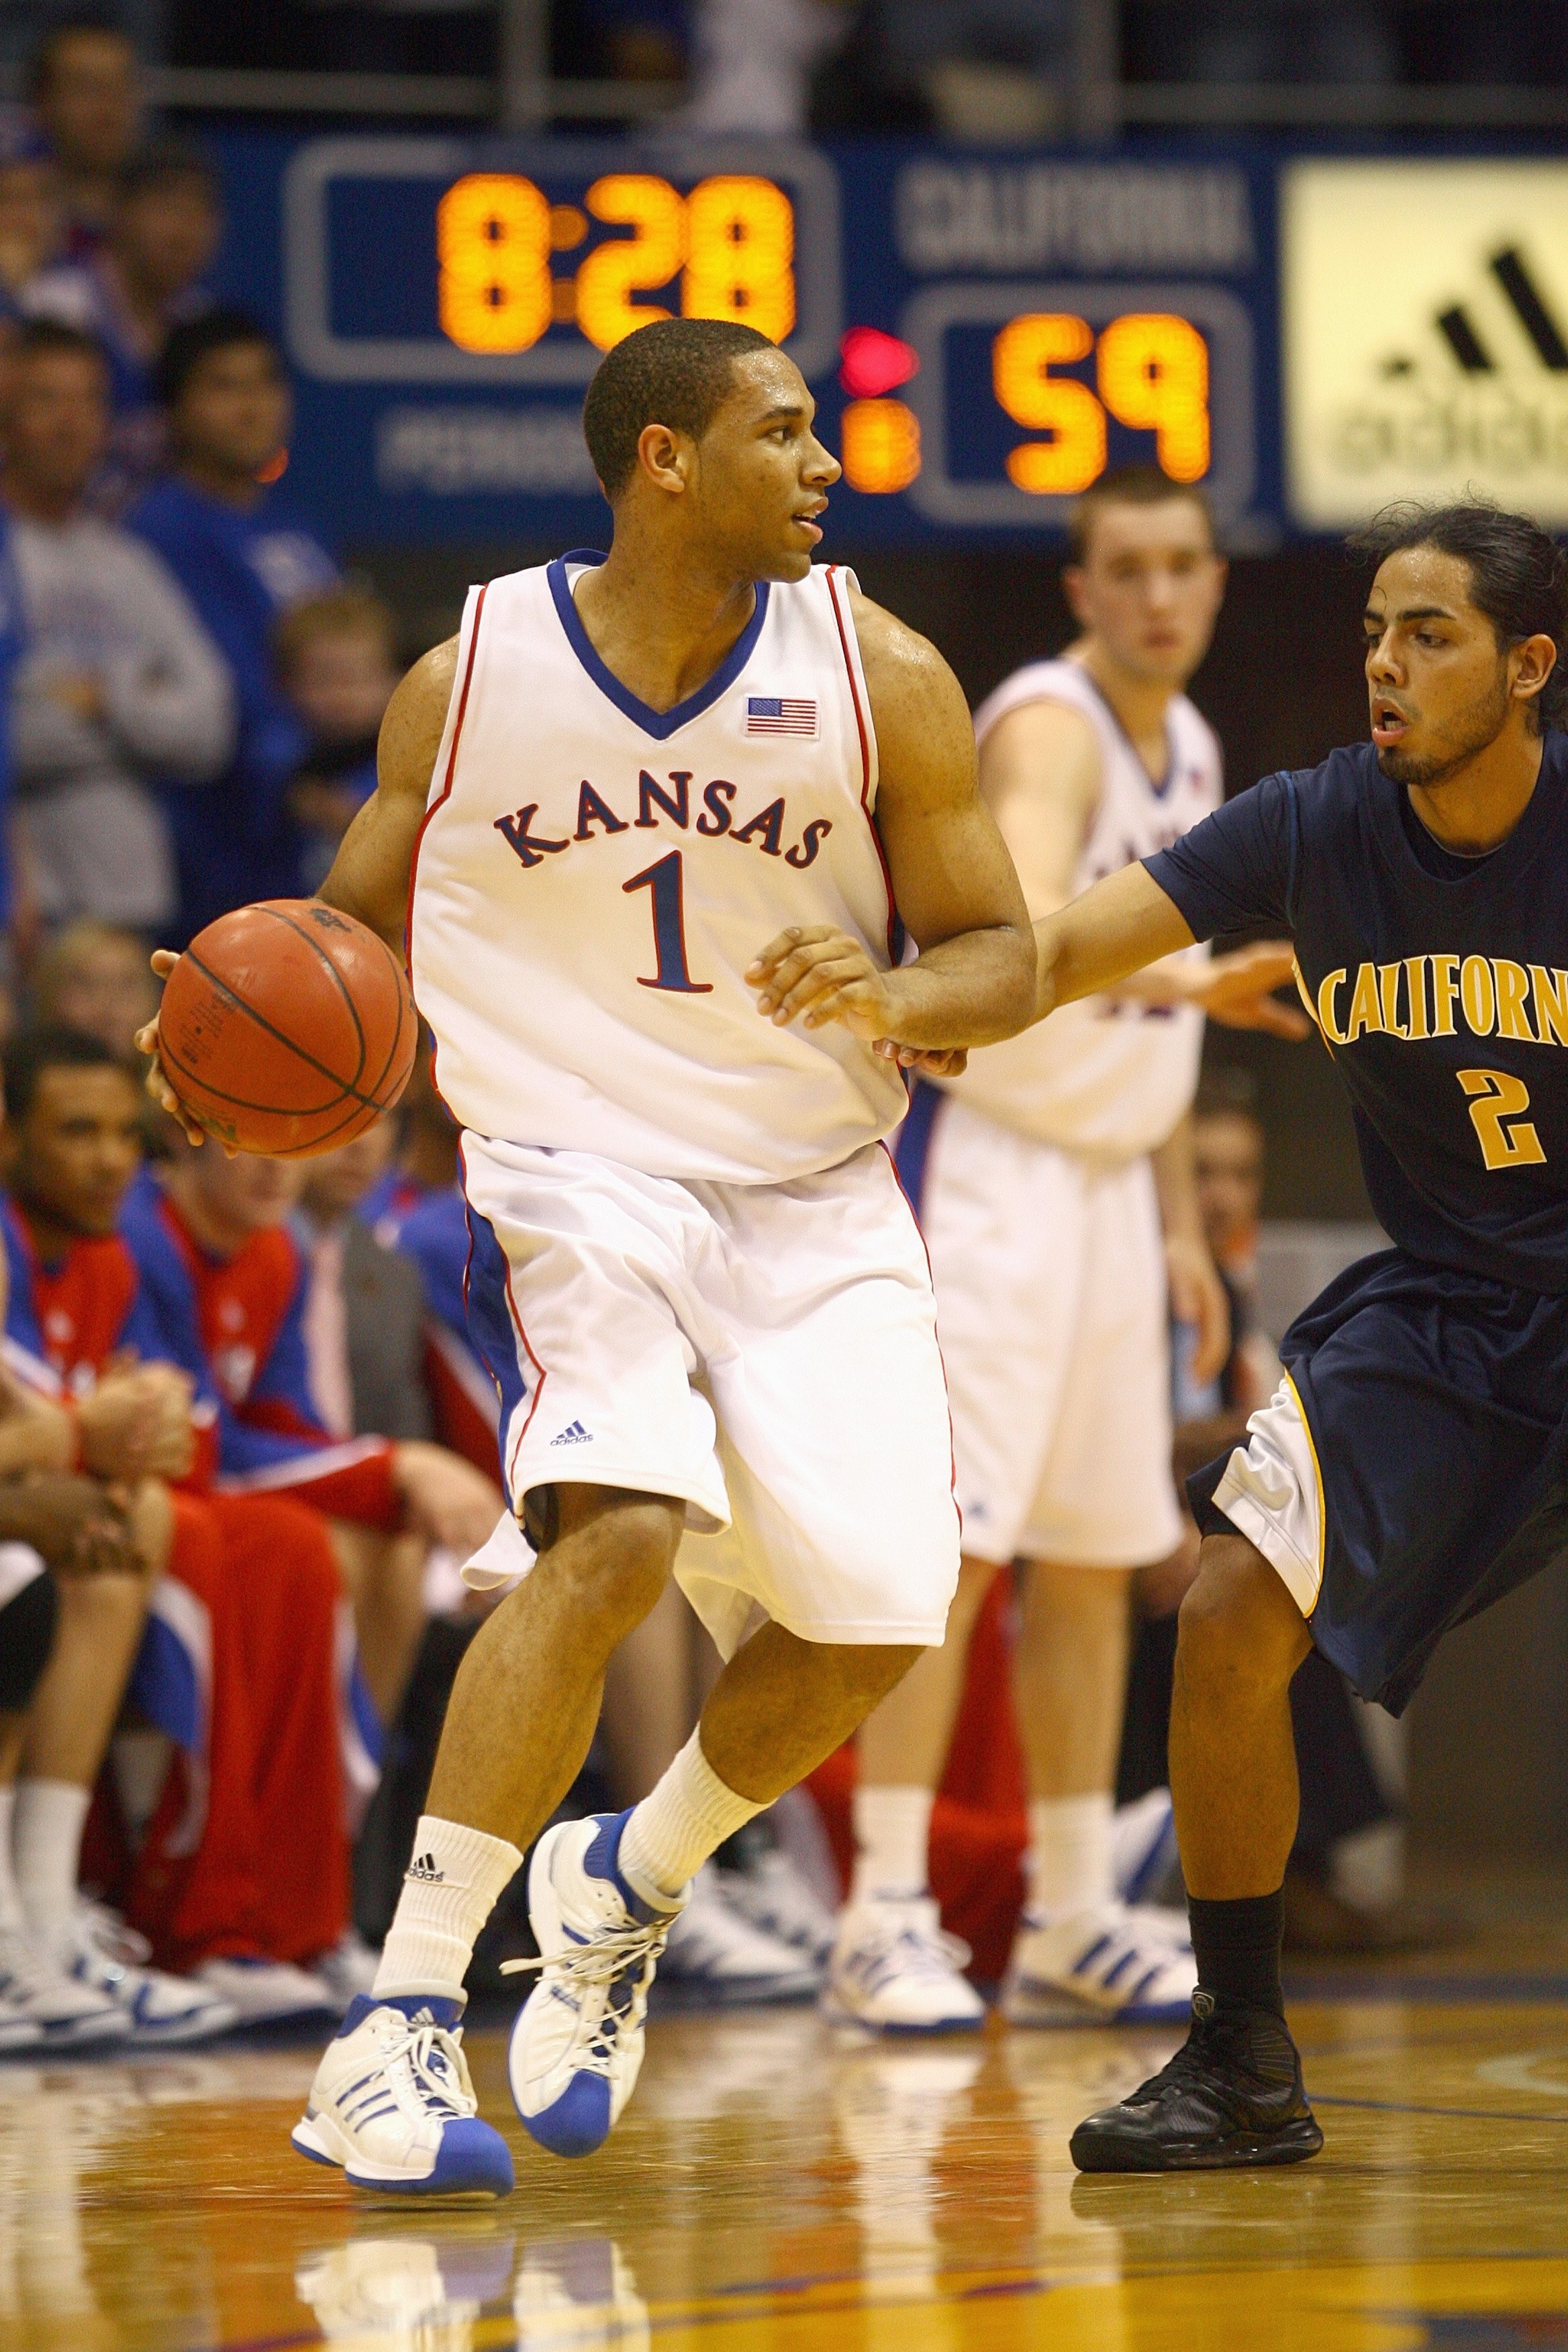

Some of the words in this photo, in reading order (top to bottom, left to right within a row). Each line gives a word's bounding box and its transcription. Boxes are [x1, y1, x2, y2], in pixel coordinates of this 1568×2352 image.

[438, 173, 795, 354] 8:28
[993, 313, 1210, 495] 59
[494, 769, 832, 869] KANSAS
[622, 849, 714, 993] 1
[1318, 954, 1568, 1048] CALIFORN
[1455, 1069, 1547, 1171] 2
[550, 1434, 594, 1447] adidas
[407, 1866, 444, 1883] didas
